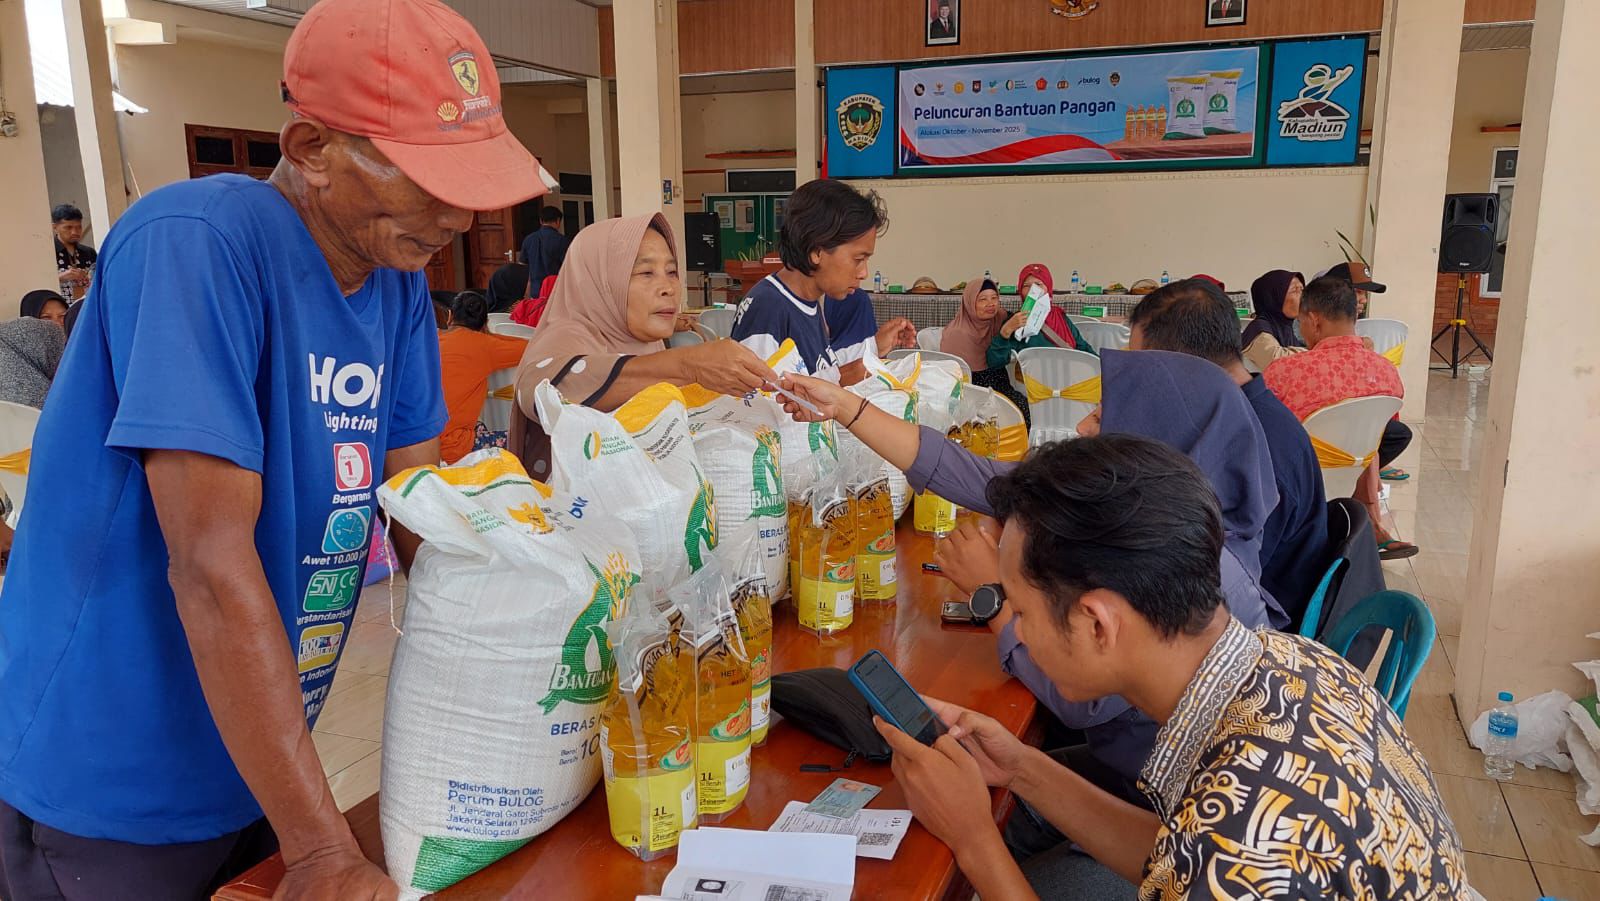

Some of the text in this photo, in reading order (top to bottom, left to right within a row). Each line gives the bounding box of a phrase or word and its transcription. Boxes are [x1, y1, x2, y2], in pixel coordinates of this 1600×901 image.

[914, 99, 1116, 120] Peluncuran Bantuan Pangan
[942, 127, 967, 135] Oktober
[971, 126, 1002, 134] November
[1283, 121, 1343, 134] Madiun
[345, 460, 353, 476] 1
[302, 555, 331, 565] Awet
[333, 551, 358, 564] 10.000
[308, 573, 338, 596] SNI
[550, 716, 595, 736] BERAS
[448, 780, 520, 795] Didistribusikan
[448, 790, 544, 807] Perum BULOG
[461, 806, 503, 818] Jenderal
[505, 810, 528, 818] Gatot
[446, 814, 483, 826] Jakarta
[484, 818, 518, 827] Selatan
